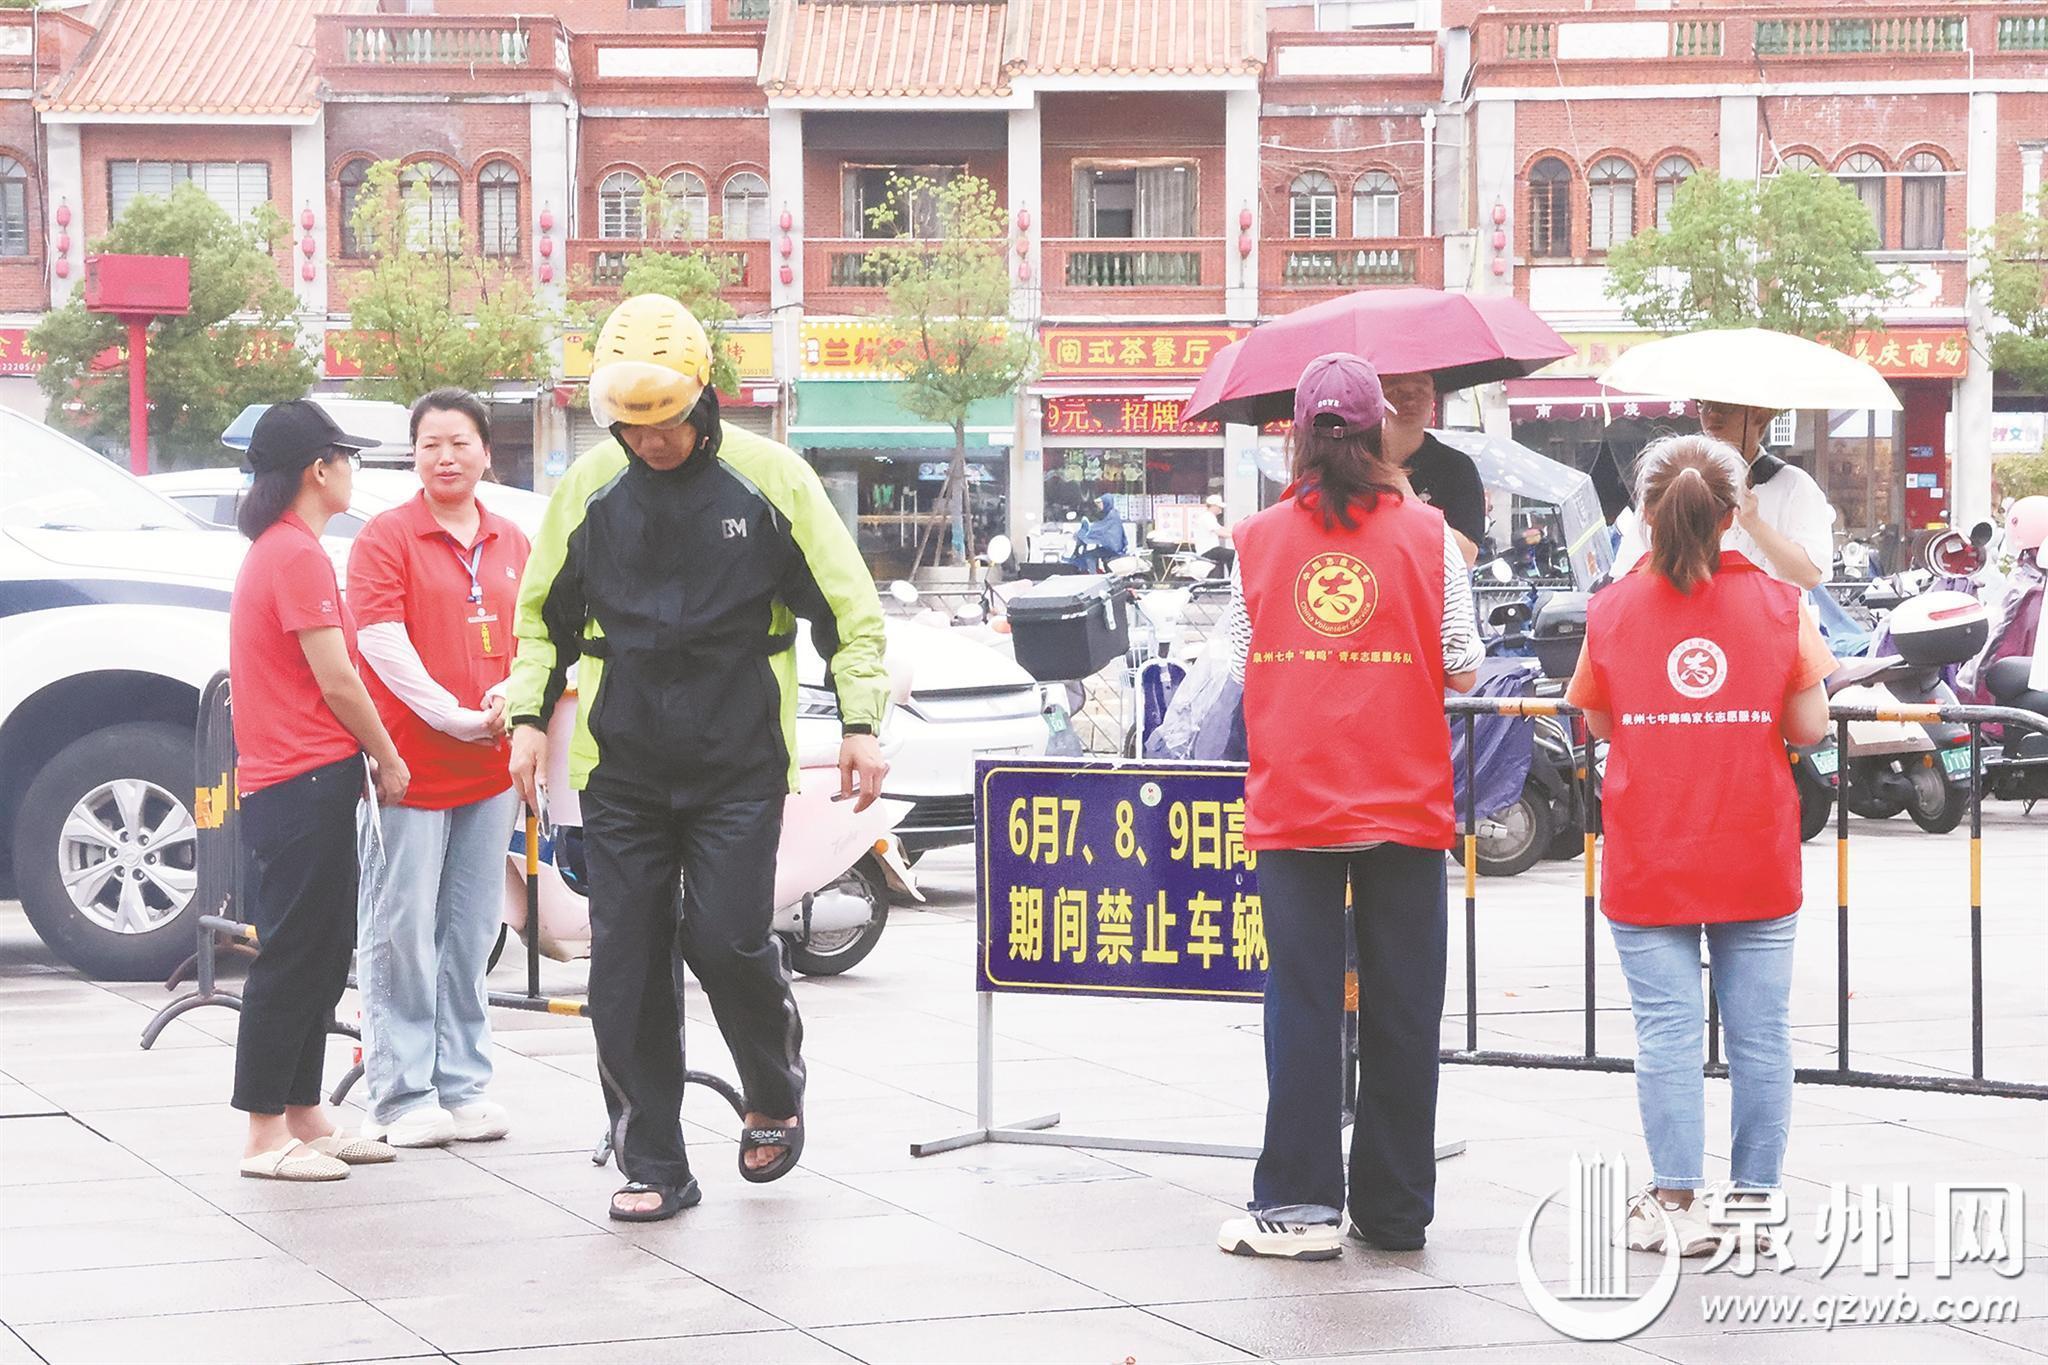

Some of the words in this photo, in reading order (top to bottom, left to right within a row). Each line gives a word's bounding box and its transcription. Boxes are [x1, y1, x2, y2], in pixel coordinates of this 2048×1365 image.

[1057, 337, 1212, 367] 闽式茶餐厅
[1048, 402, 1219, 431] 9元、招牌
[1008, 885, 1270, 971] 期间禁止车辆
